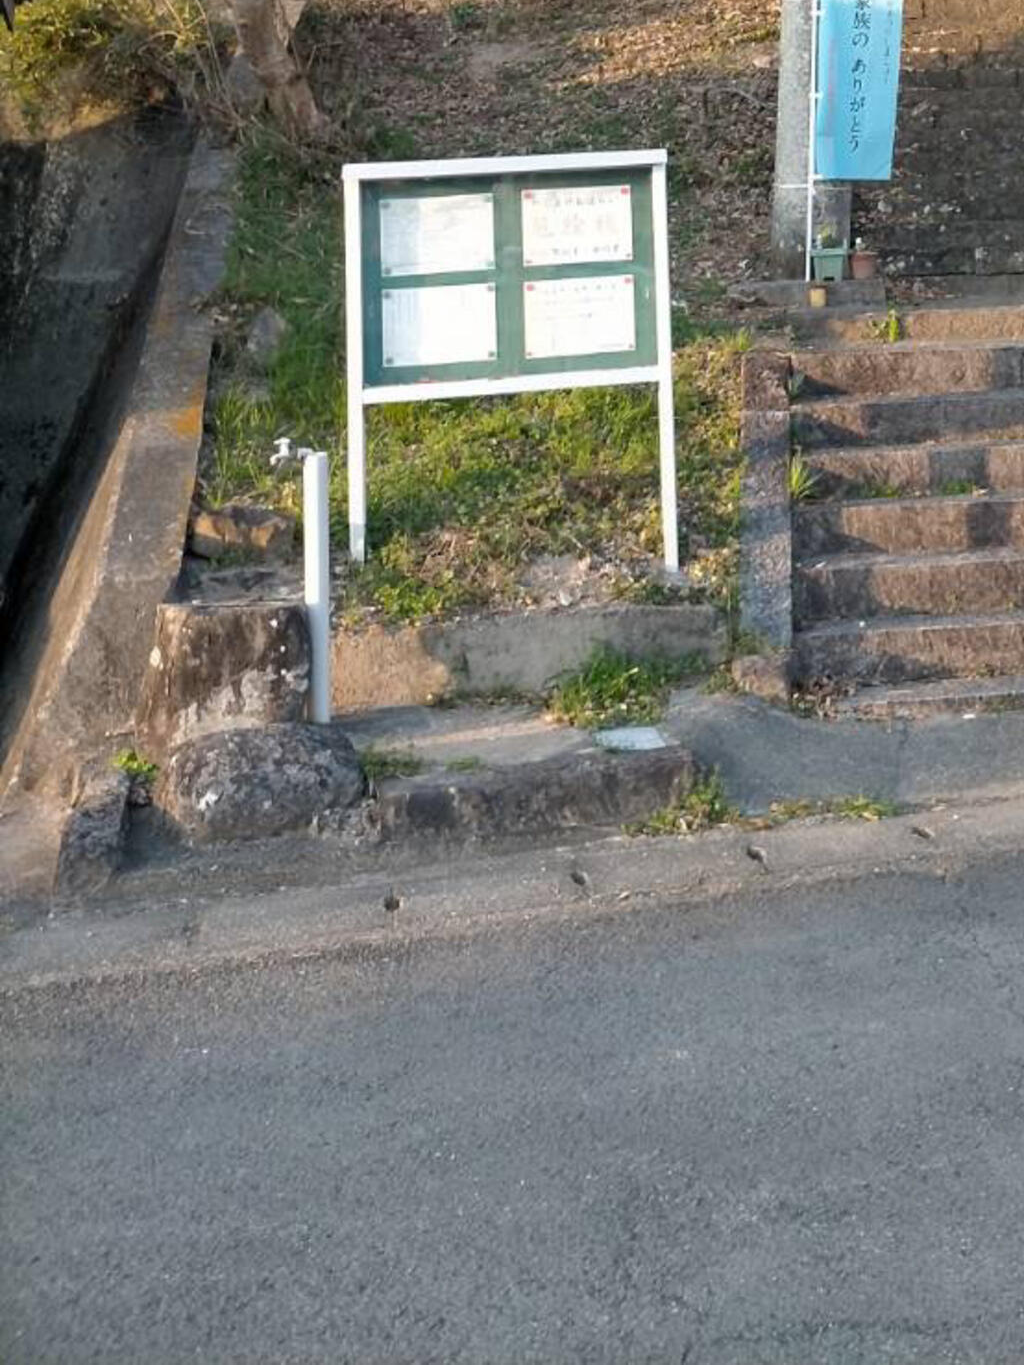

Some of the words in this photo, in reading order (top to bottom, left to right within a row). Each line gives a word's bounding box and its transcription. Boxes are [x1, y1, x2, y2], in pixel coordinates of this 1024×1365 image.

[847, 58, 868, 153] ありがとう
